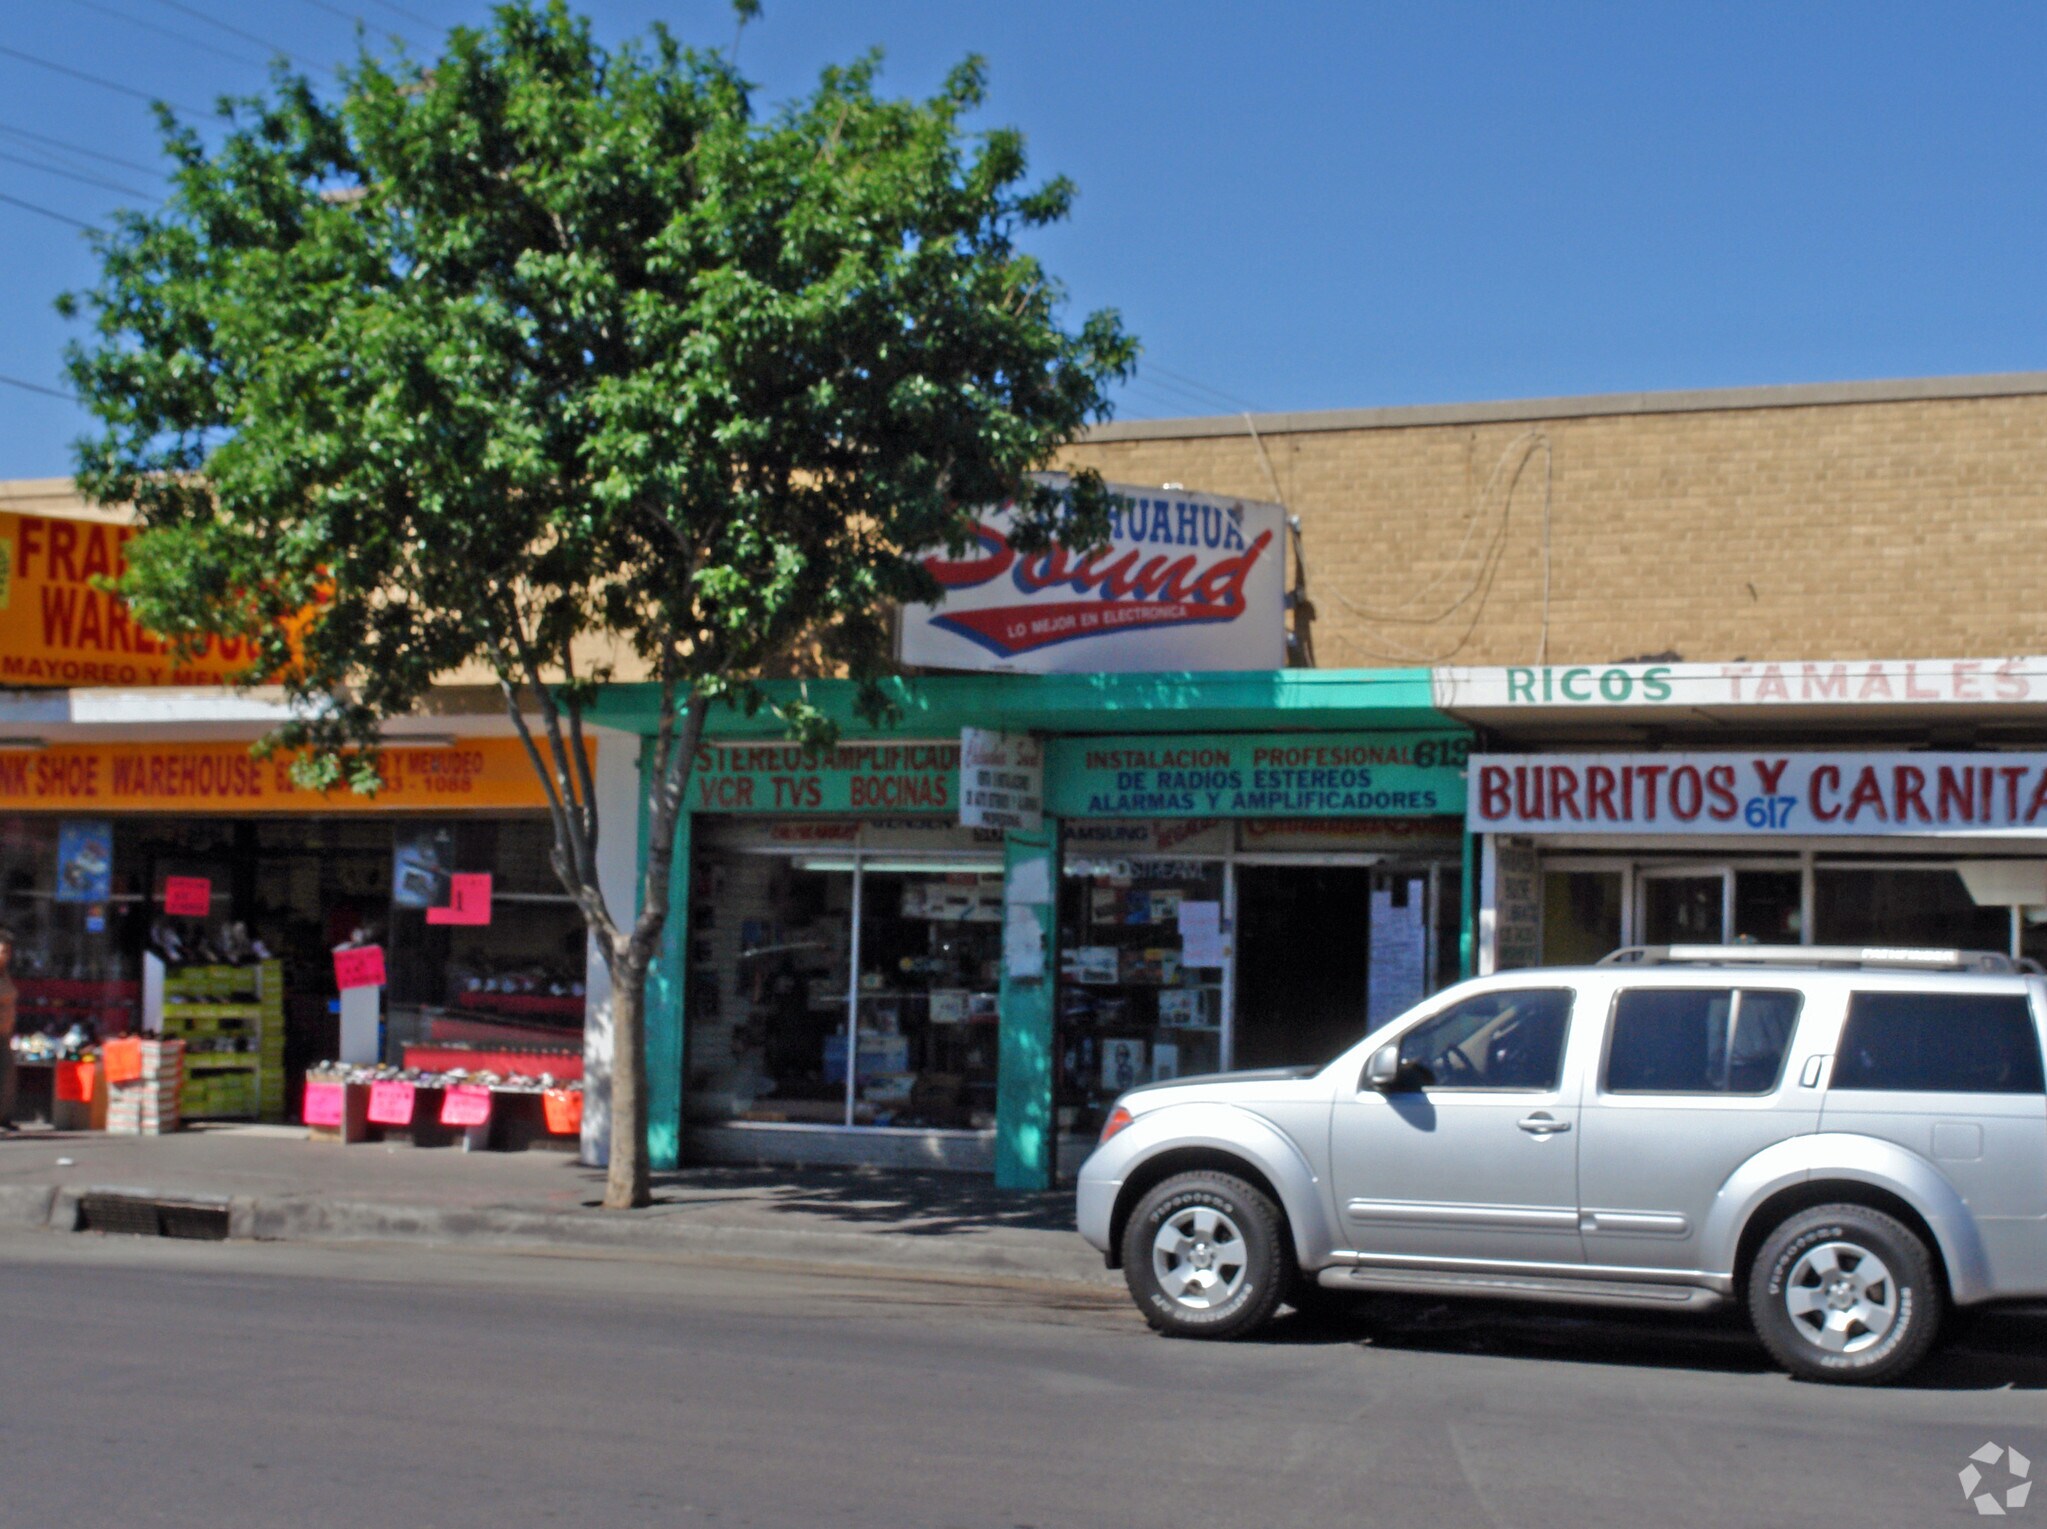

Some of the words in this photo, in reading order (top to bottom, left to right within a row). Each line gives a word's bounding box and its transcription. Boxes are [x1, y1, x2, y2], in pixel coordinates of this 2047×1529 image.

[1007, 622, 1026, 638] LO
[1031, 614, 1076, 634] MEJOR
[1081, 611, 1099, 626] EN
[1103, 603, 1187, 624] ELECTRONICA
[2, 655, 137, 684] MAYOREO
[147, 666, 162, 685] Y
[1507, 667, 1671, 701] RICOS
[1721, 662, 2030, 700] TAMALES
[1086, 750, 1230, 769] INSTALACION
[1254, 747, 1416, 767] PROFESIONAL
[37, 756, 98, 796] SHOE
[112, 755, 262, 796] WAREHOUSE
[700, 776, 753, 806] VCR
[771, 777, 822, 807] TVS
[851, 775, 947, 807] BOCINAS
[1117, 771, 1146, 790] DE
[1157, 770, 1242, 790] RADIOS
[1254, 768, 1371, 789] ESTEREOS
[1480, 765, 1739, 821] BURRITOS
[1753, 759, 1788, 795] Y
[1088, 793, 1194, 812] ALARMAS
[1205, 792, 1220, 809] Y
[1231, 790, 1437, 809] AMPLIFICADORES
[1745, 797, 1796, 829] 617
